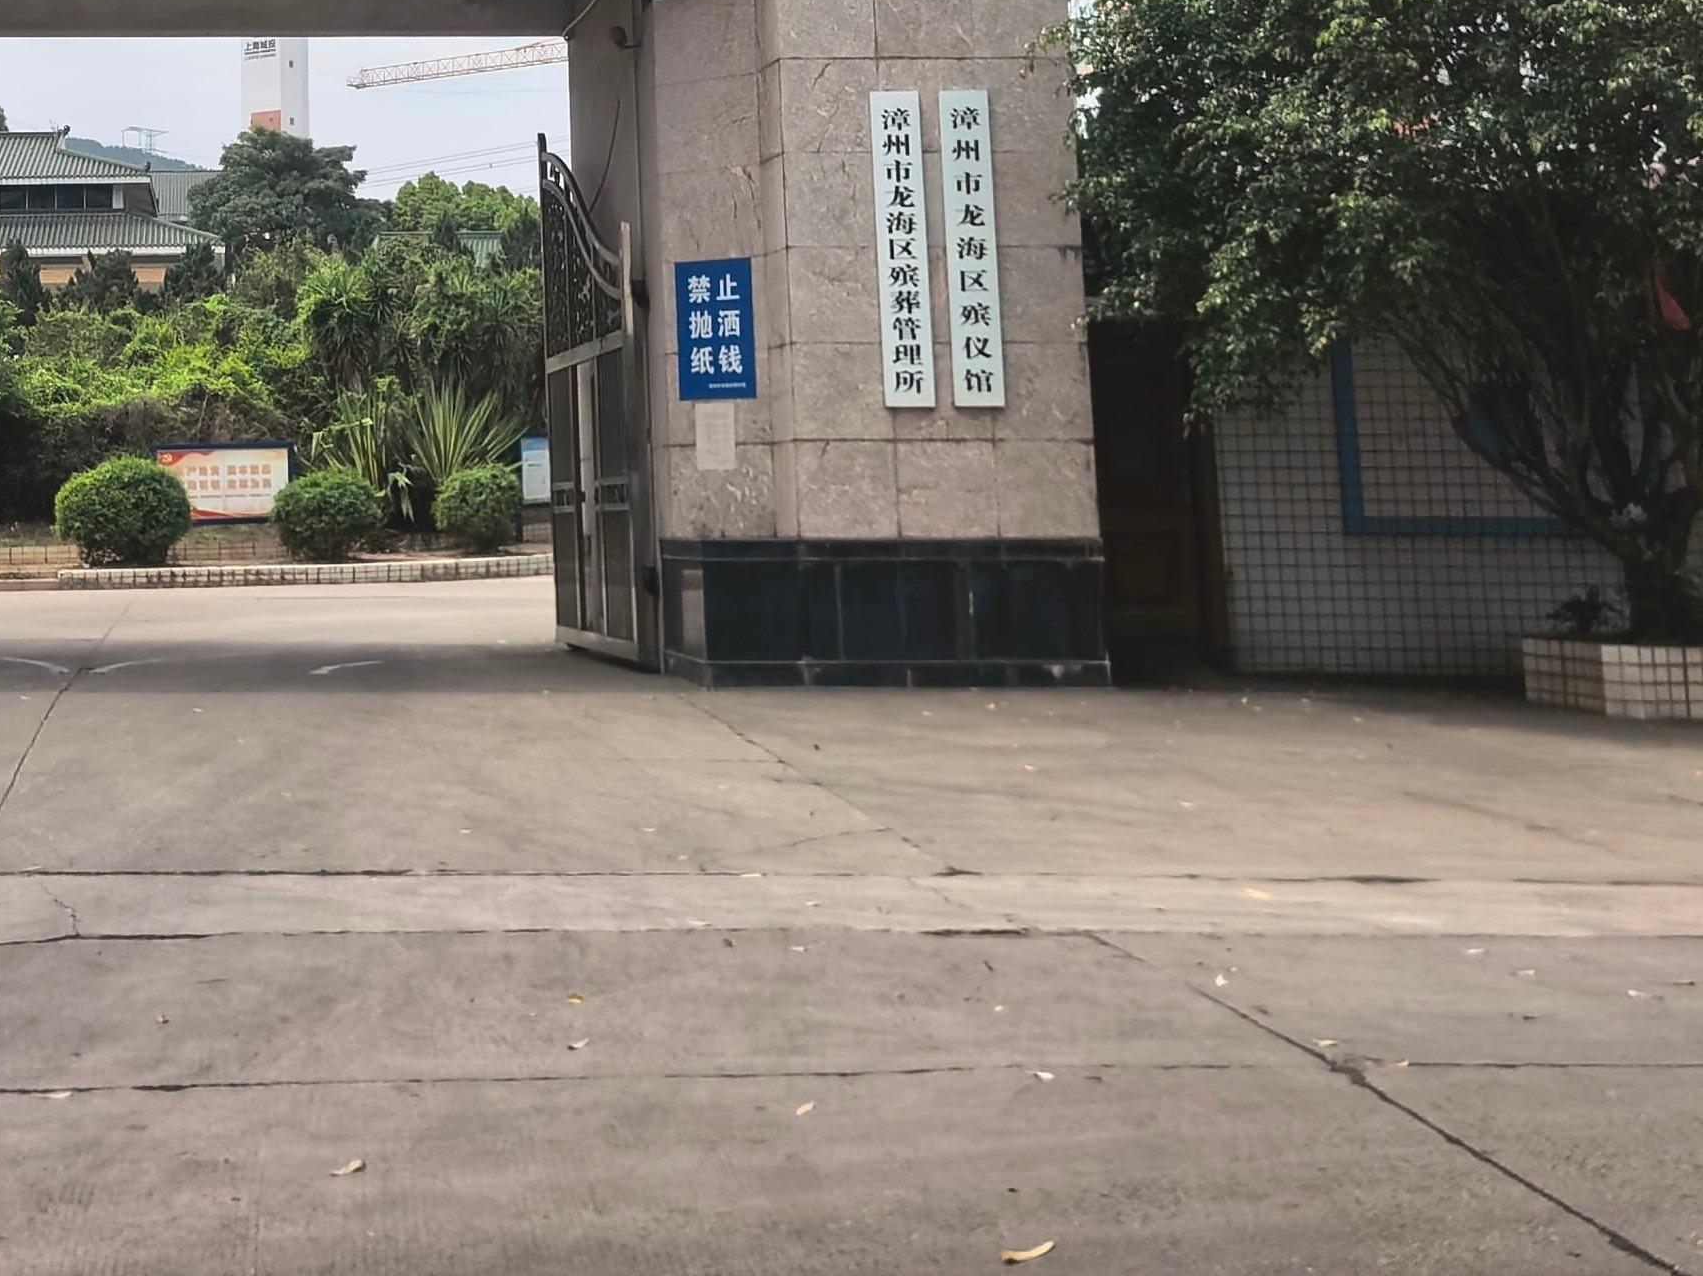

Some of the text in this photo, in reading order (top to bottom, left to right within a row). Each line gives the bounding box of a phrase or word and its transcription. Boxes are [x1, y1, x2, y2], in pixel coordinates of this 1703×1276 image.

[881, 107, 924, 395] 漳州市龙海区殡葬管理所
[950, 106, 994, 393] 漳州市龙海区殡仪馆
[688, 274, 740, 304] 禁止
[689, 310, 741, 339] 抛洒
[690, 344, 743, 374] 纸钱
